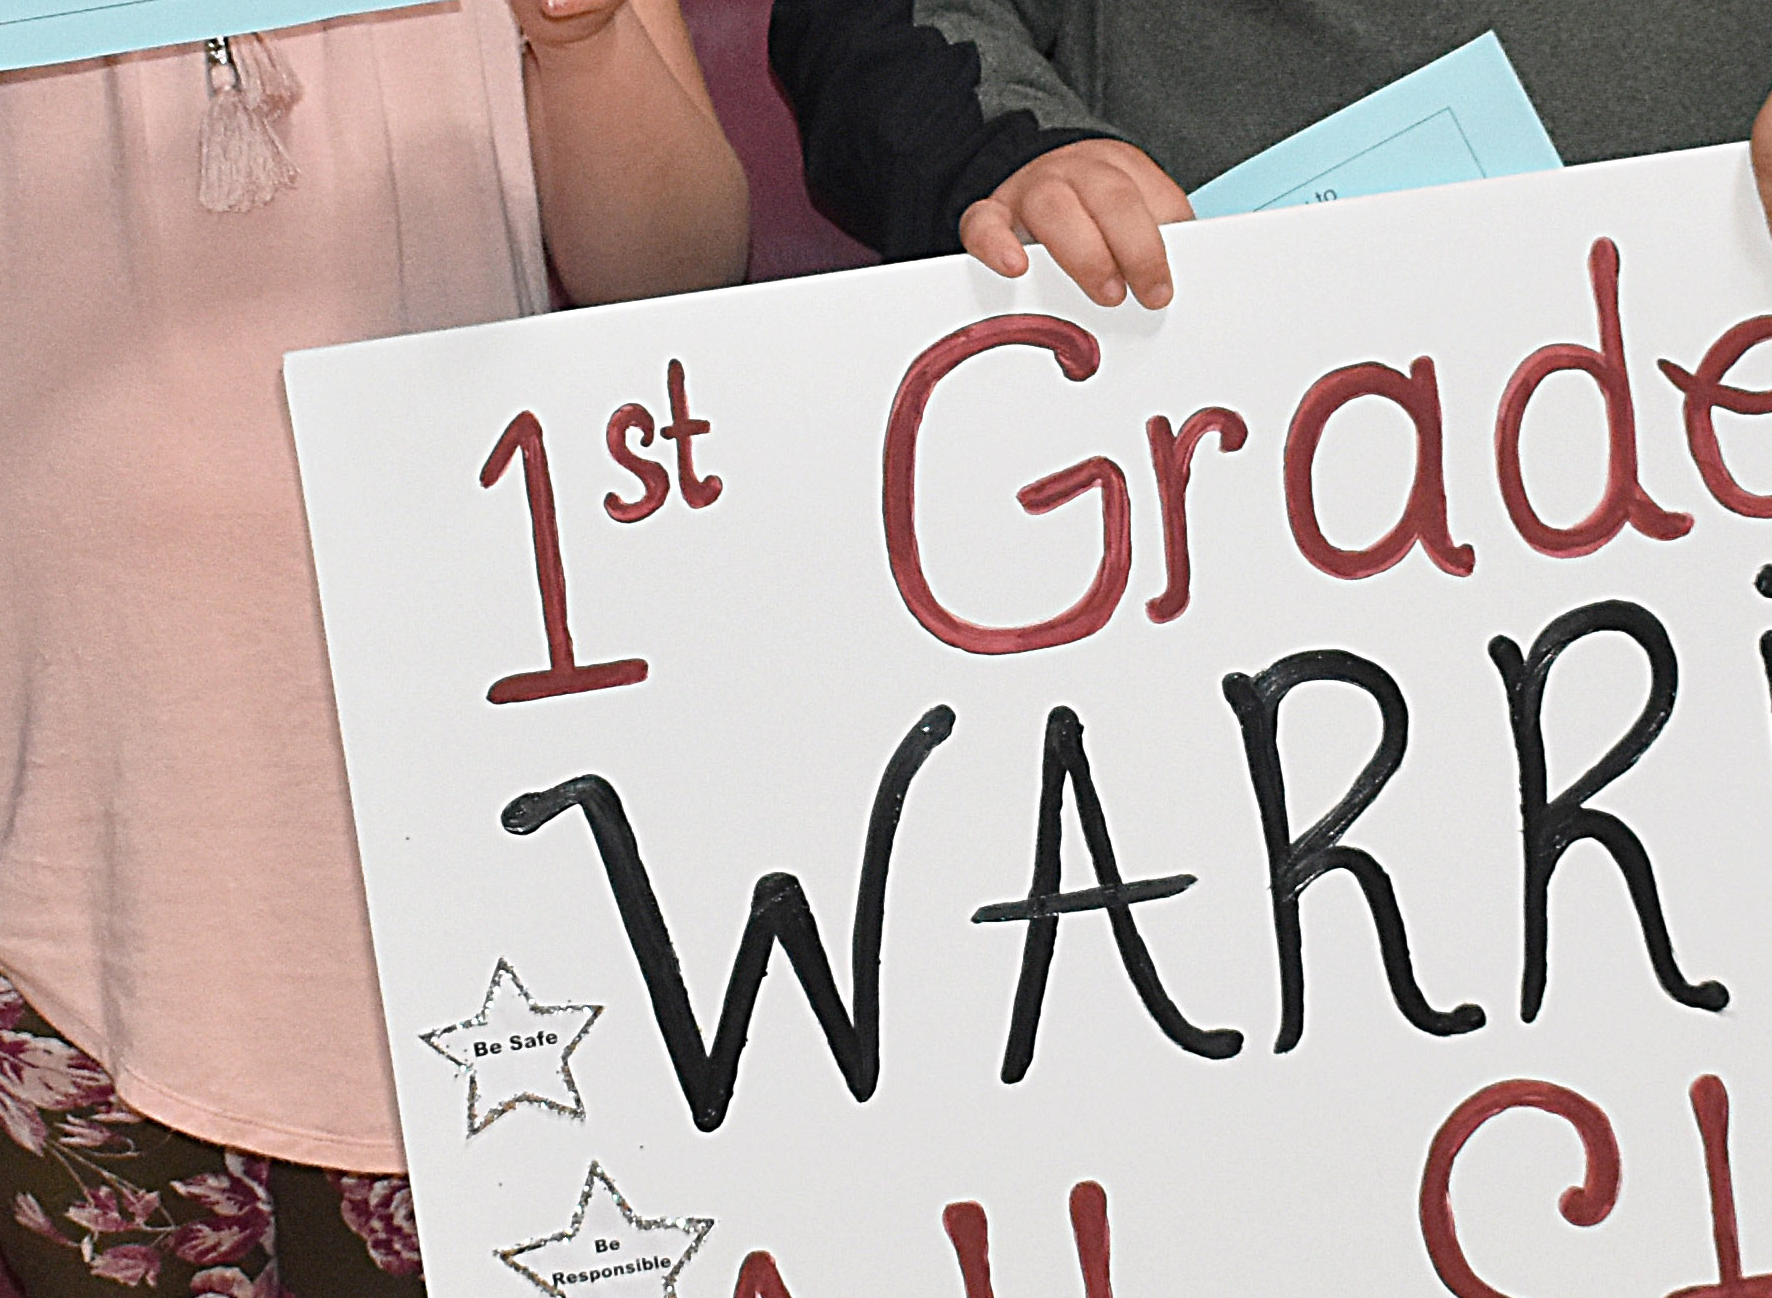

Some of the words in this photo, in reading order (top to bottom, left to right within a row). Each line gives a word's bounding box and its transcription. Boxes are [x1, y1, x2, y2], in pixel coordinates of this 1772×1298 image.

[480, 359, 724, 705] 1st
[473, 1041, 503, 1058] Be
[509, 1030, 558, 1051] Safe
[594, 1238, 621, 1253] Be
[552, 1255, 672, 1287] Responsible
